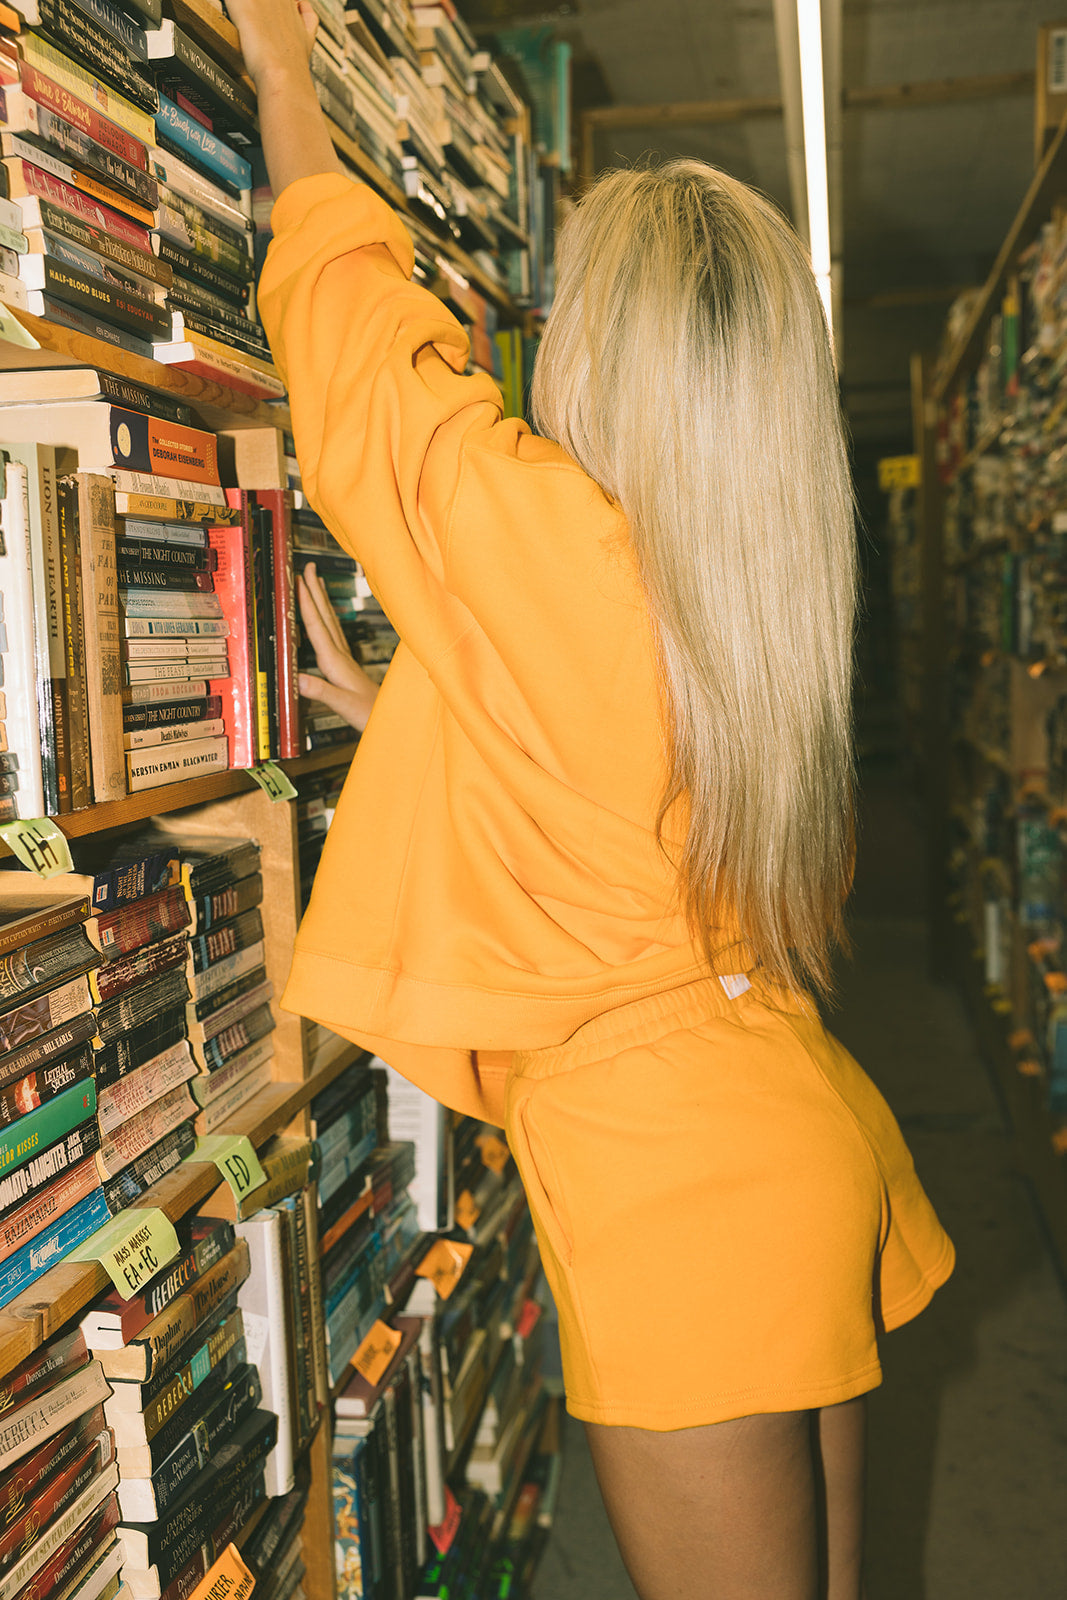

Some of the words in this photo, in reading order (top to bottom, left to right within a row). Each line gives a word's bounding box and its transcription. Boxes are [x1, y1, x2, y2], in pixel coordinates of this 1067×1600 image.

[180, 43, 189, 58] The
[190, 48, 215, 82] WOMAN
[215, 74, 234, 101] INSIDE
[33, 71, 54, 100] Jane
[62, 93, 92, 127] Edward
[98, 120, 125, 144] MELODIE
[170, 108, 190, 140] Brush
[98, 130, 127, 156] EDWARDS
[28, 166, 42, 192] The
[42, 174, 60, 202] Next
[60, 184, 76, 211] Big
[76, 194, 96, 219] Thing
[126, 169, 137, 188] book
[49, 268, 90, 294] HALF-BLOOD
[91, 286, 111, 303] BLUES
[116, 298, 126, 310] ESI
[127, 304, 154, 322] EDUGYAN
[104, 379, 121, 400] THE
[122, 383, 150, 408] MISSING
[153, 448, 178, 462] DEBORAH
[178, 454, 205, 468] EISENBERG
[159, 438, 178, 449] COLLECTED
[179, 443, 193, 453] STORIES
[43, 468, 52, 514] LION
[47, 518, 51, 529] on
[62, 544, 70, 588] LAND
[141, 548, 152, 560] THE
[152, 548, 170, 562] NIGHT
[171, 550, 196, 565] COUNTRY
[120, 570, 130, 586] HE
[133, 570, 167, 586] MISSING
[47, 558, 58, 639] HEARTH
[64, 593, 75, 677] BREAKERS
[154, 666, 166, 678] THE
[167, 666, 184, 677] FEAST
[152, 685, 168, 698] FROM
[172, 683, 204, 696] ROCKAWAY
[54, 693, 63, 723] JOHN
[148, 710, 158, 722] THE
[158, 708, 176, 721] NIGHT
[176, 706, 201, 719] COUNTRY
[56, 725, 64, 758] EHLE
[131, 763, 158, 778] KERSTIN
[158, 760, 180, 772] EKMAN
[183, 752, 218, 768] BLACKWATER
[18, 827, 59, 872] EH
[9, 1052, 42, 1074] GLADIATOR
[44, 1038, 55, 1059] BILL
[56, 1032, 73, 1052] EARLS
[44, 1062, 67, 1085] LETHAL
[52, 1070, 77, 1094] SECRETS
[17, 1132, 39, 1157] KISSES
[67, 1131, 81, 1148] JACK
[68, 1143, 83, 1163] EARLY
[29, 1142, 68, 1188] DAUGHTER
[224, 1155, 250, 1192] ED
[4, 1196, 57, 1245] RAZZAMATAZZ
[113, 1246, 131, 1267] MASS
[128, 1225, 152, 1253] MARKET
[7, 1266, 22, 1285] EARLY
[152, 1254, 197, 1318] REBECCA
[197, 1288, 209, 1310] The
[209, 1270, 229, 1297] House
[154, 1319, 182, 1350] Daphne
[209, 1328, 225, 1349] DAPHNE
[156, 1372, 194, 1424] REBECCA
[0, 1407, 49, 1456] REBECCA
[171, 1450, 191, 1474] DAPHNE
[176, 1456, 199, 1484] MAURIER
[160, 1538, 169, 1550] DU
[169, 1506, 203, 1542] MAURIER
[166, 1501, 195, 1533] DAPHNE
[172, 1527, 197, 1561] DAPHNE
